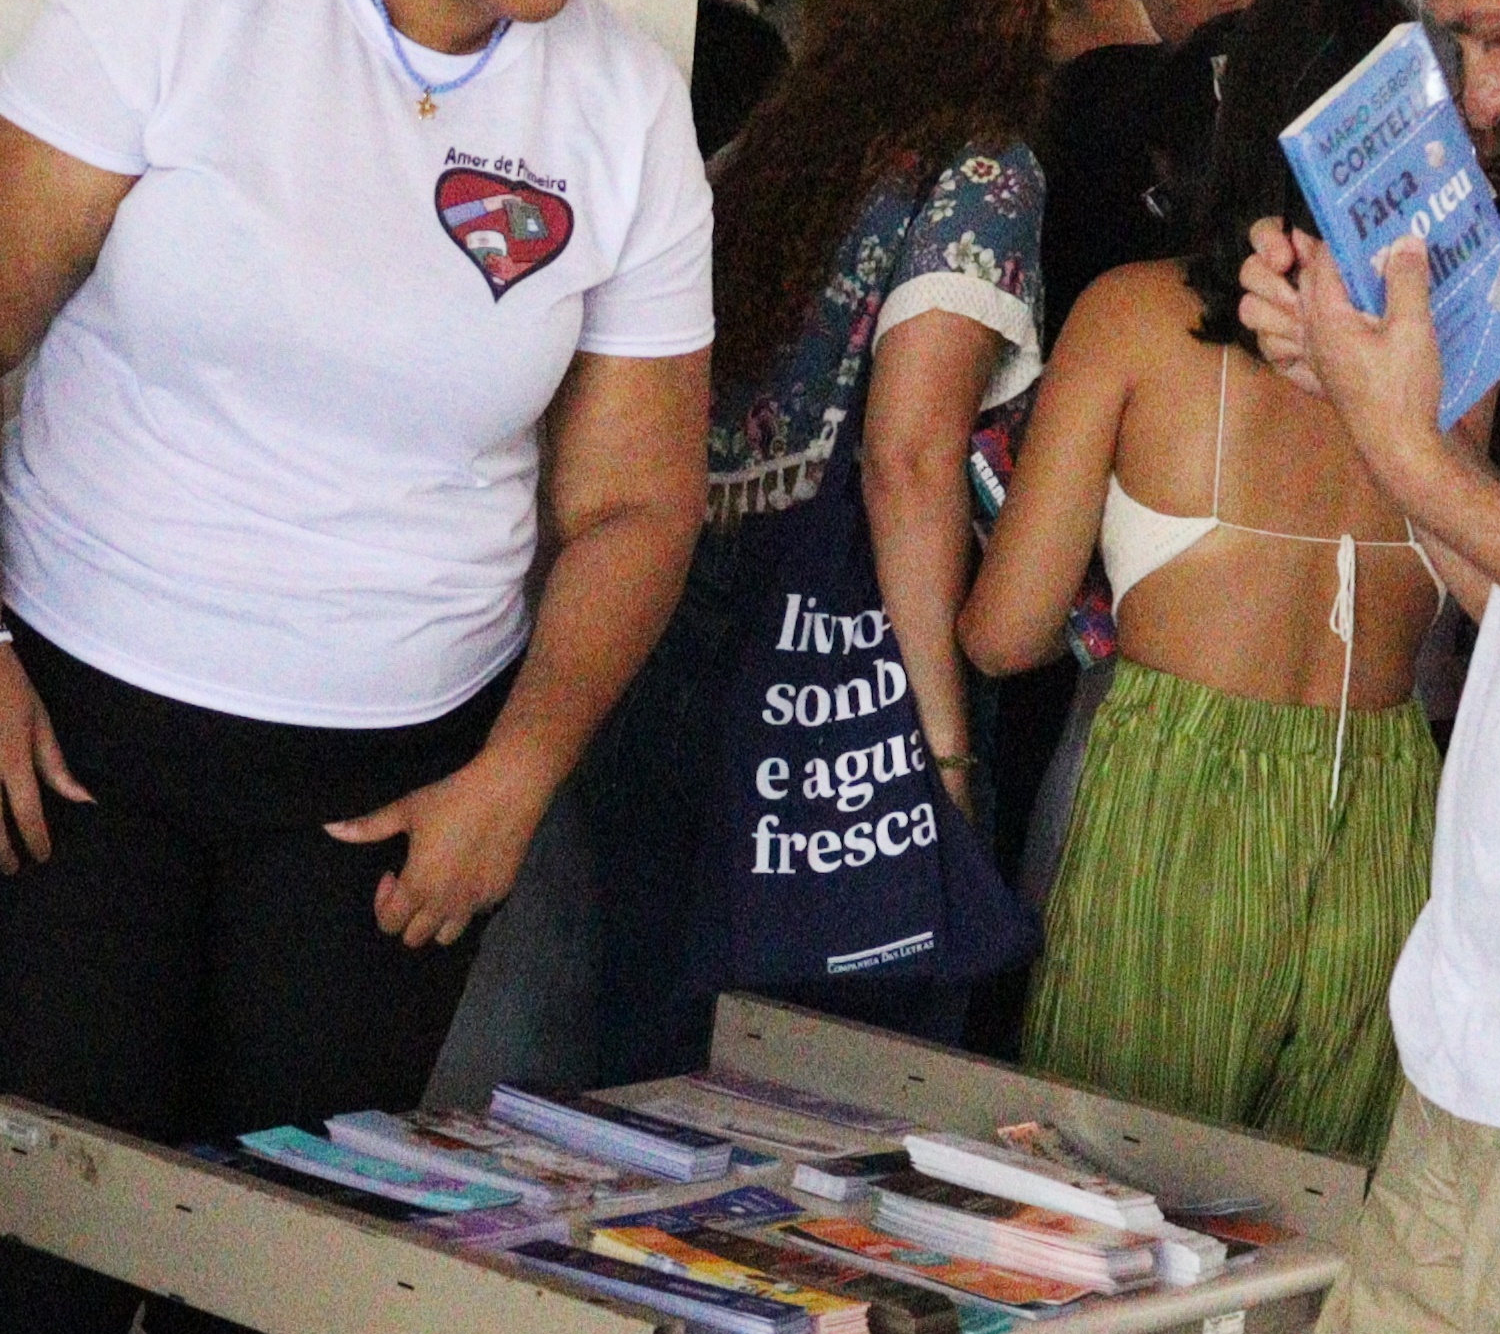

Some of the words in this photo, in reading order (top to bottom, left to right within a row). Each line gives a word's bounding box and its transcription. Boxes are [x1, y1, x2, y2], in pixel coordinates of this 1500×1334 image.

[444, 146, 489, 166] Amor
[494, 155, 513, 174] de
[1349, 167, 1418, 240] Faça
[1411, 210, 1431, 238] o
[1428, 169, 1474, 221] teu
[1429, 203, 1491, 286] lhor!
[755, 756, 790, 800] e
[751, 802, 938, 875] fresca
